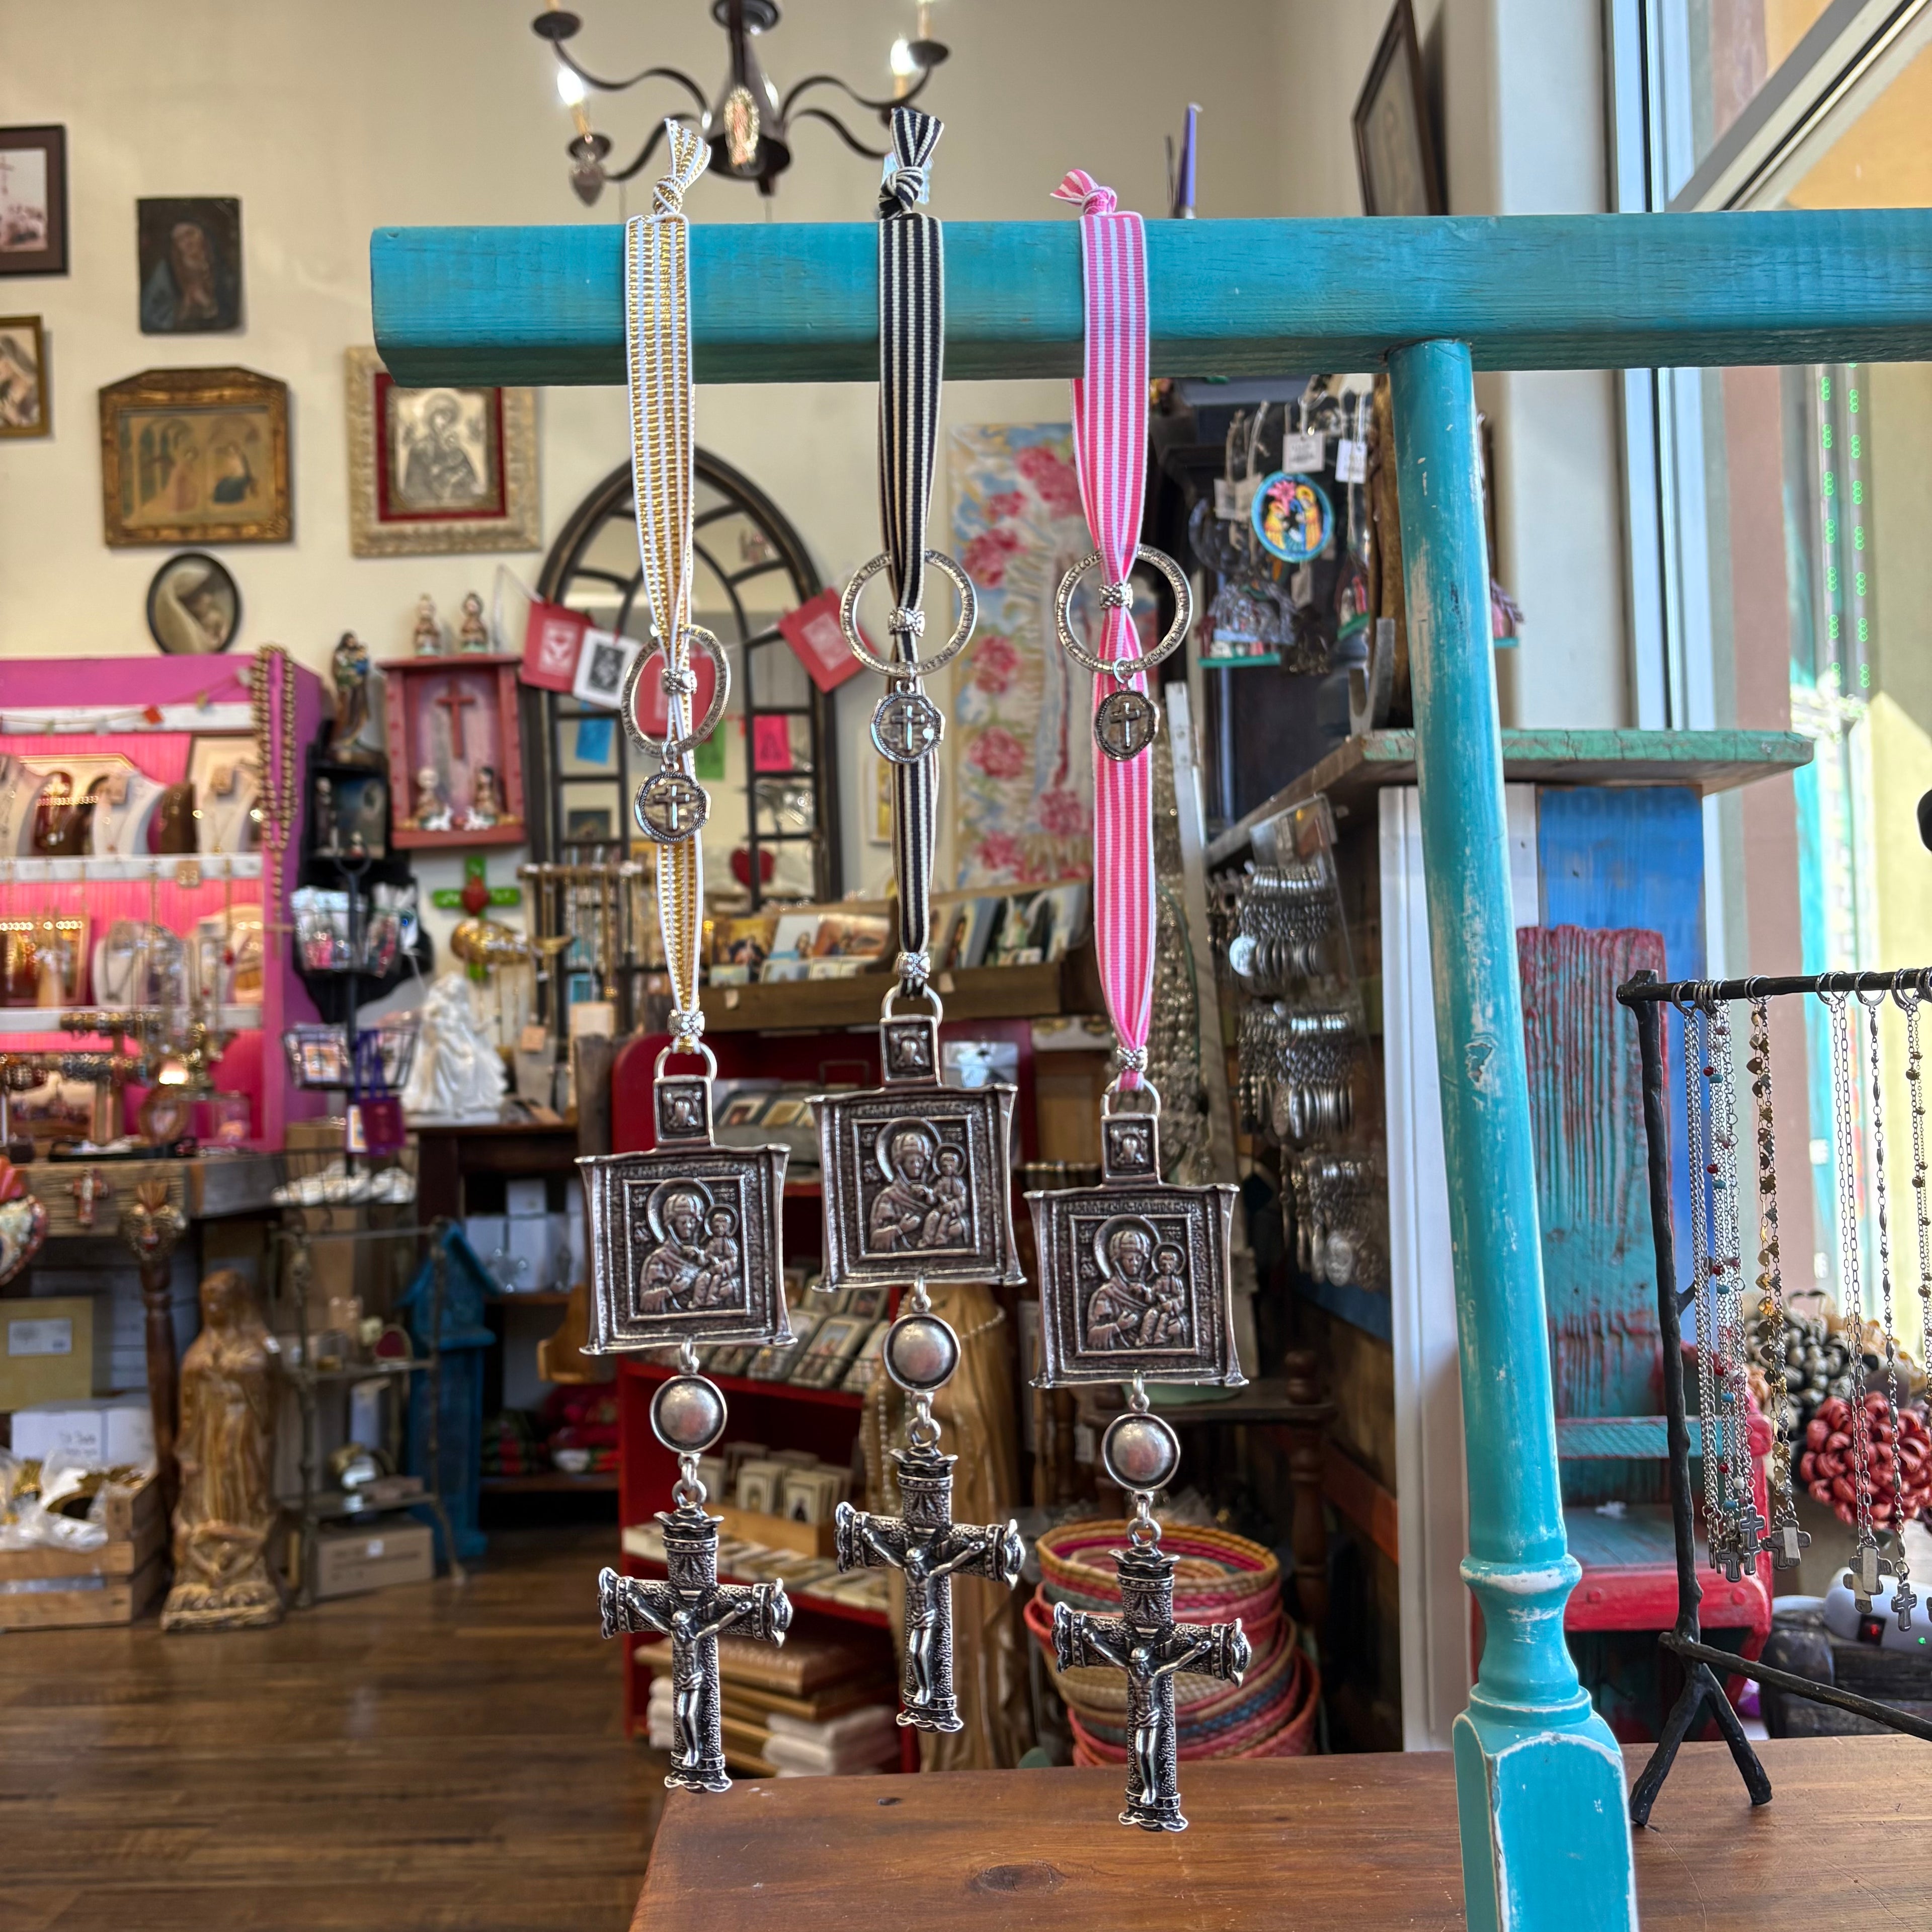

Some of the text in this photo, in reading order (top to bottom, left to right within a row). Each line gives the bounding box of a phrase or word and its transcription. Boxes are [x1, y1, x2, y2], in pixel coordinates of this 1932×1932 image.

[866, 554, 892, 574] TRUST
[1078, 550, 1101, 571] LOVE
[1142, 649, 1165, 667] HOPE
